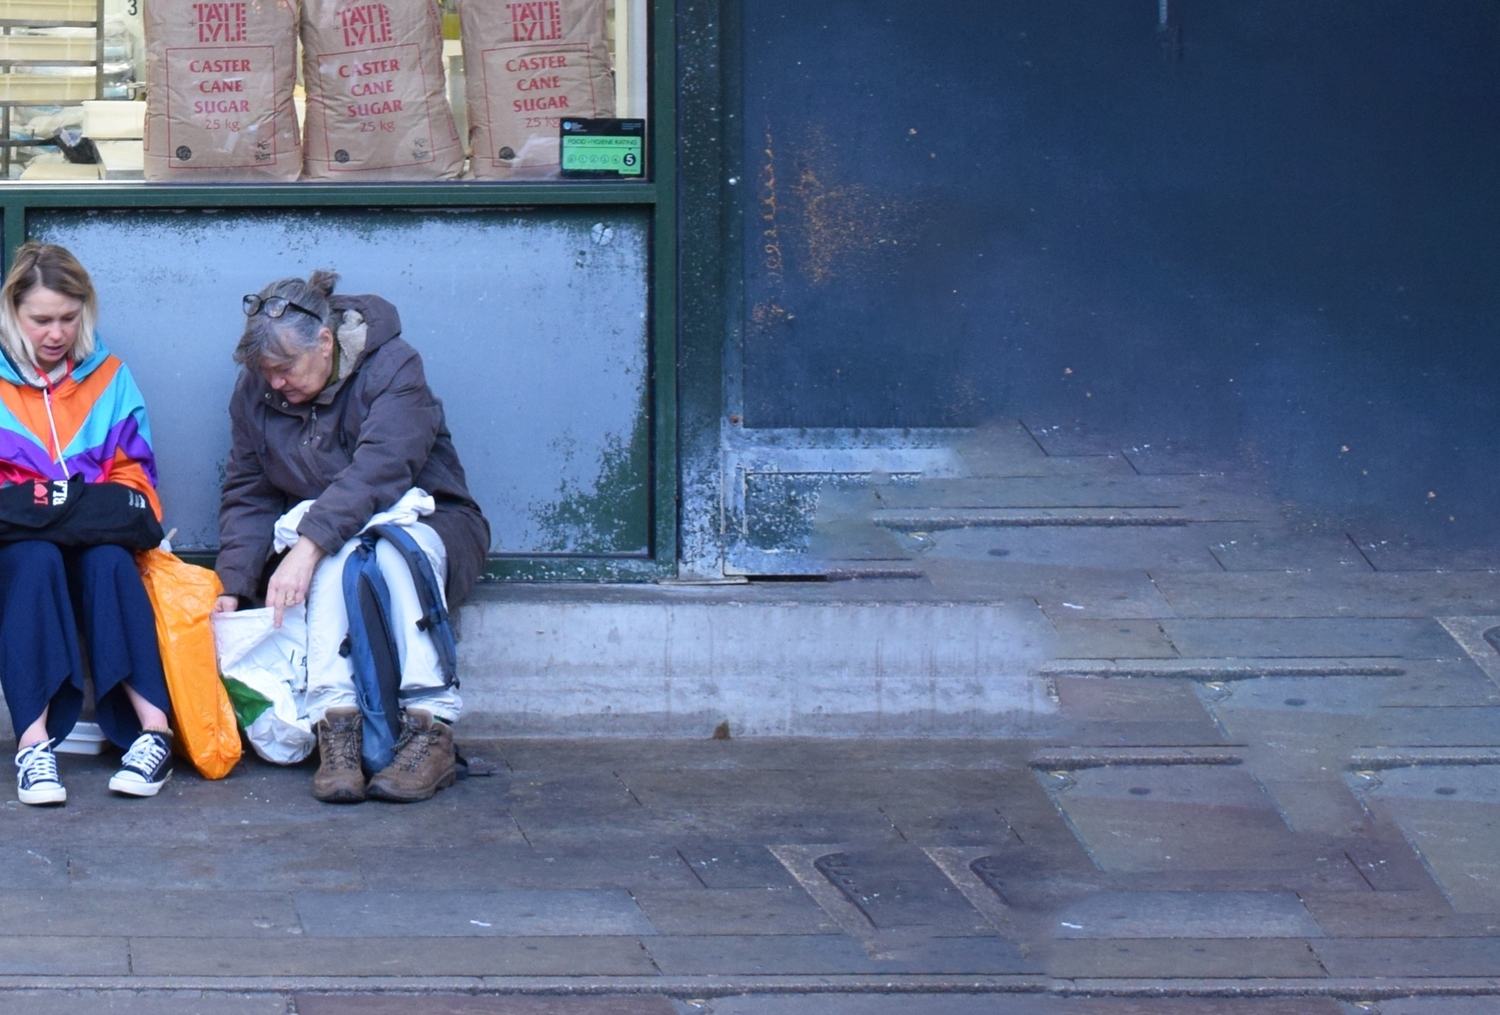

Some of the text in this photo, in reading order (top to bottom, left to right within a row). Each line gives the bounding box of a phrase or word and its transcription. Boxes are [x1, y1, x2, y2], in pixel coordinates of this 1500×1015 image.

[192, 3, 246, 22] TATE
[336, 3, 390, 27] TATE
[506, 1, 560, 22] TATE
[198, 22, 247, 42] LYLE
[343, 22, 393, 47] LYLE
[512, 20, 562, 42] LYLE
[189, 59, 251, 73] CASTER
[338, 59, 400, 78] CASTER
[505, 56, 567, 72] CASTER
[199, 80, 243, 93] CANE
[351, 80, 395, 97] CANE
[516, 76, 561, 91] CANE
[194, 100, 250, 114] SUGAR
[347, 99, 403, 117] SUGAR
[512, 95, 569, 113] SUGAR
[205, 119, 240, 132] 25 kg
[360, 121, 395, 132] 25 kg
[525, 117, 541, 128] 25
[626, 155, 634, 165] 5
